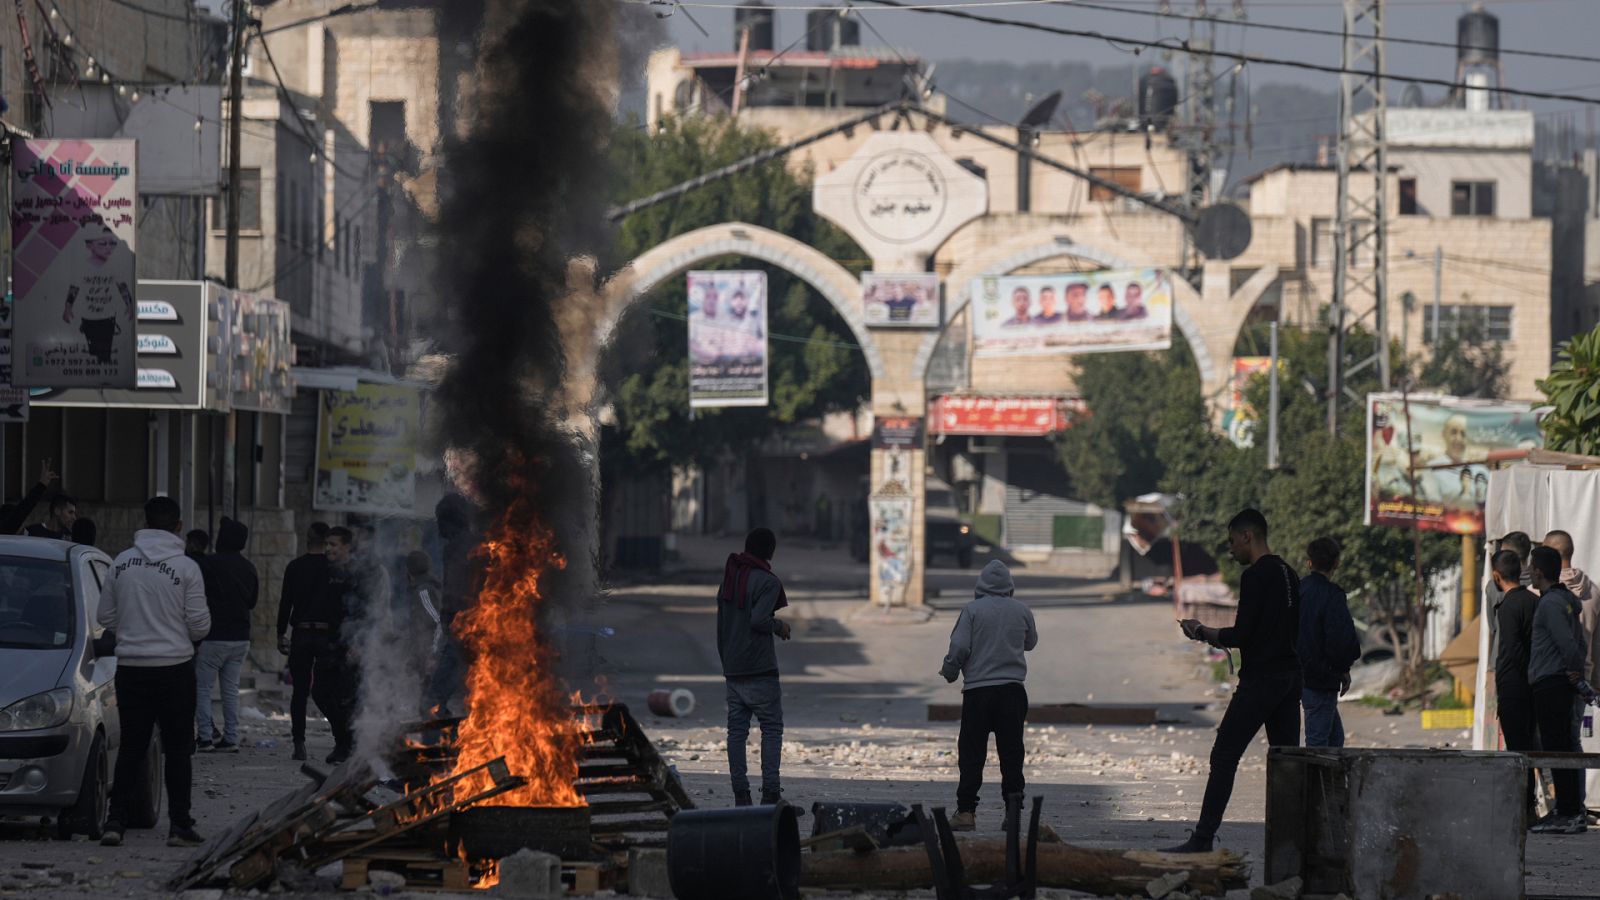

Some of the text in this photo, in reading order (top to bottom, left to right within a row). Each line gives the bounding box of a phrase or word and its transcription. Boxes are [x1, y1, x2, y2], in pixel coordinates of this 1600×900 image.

[17, 158, 45, 182] أخي
[60, 158, 73, 176] أنا
[75, 161, 129, 181] مؤسسة
[73, 193, 102, 210] أطفال
[103, 195, 132, 210] ملابس
